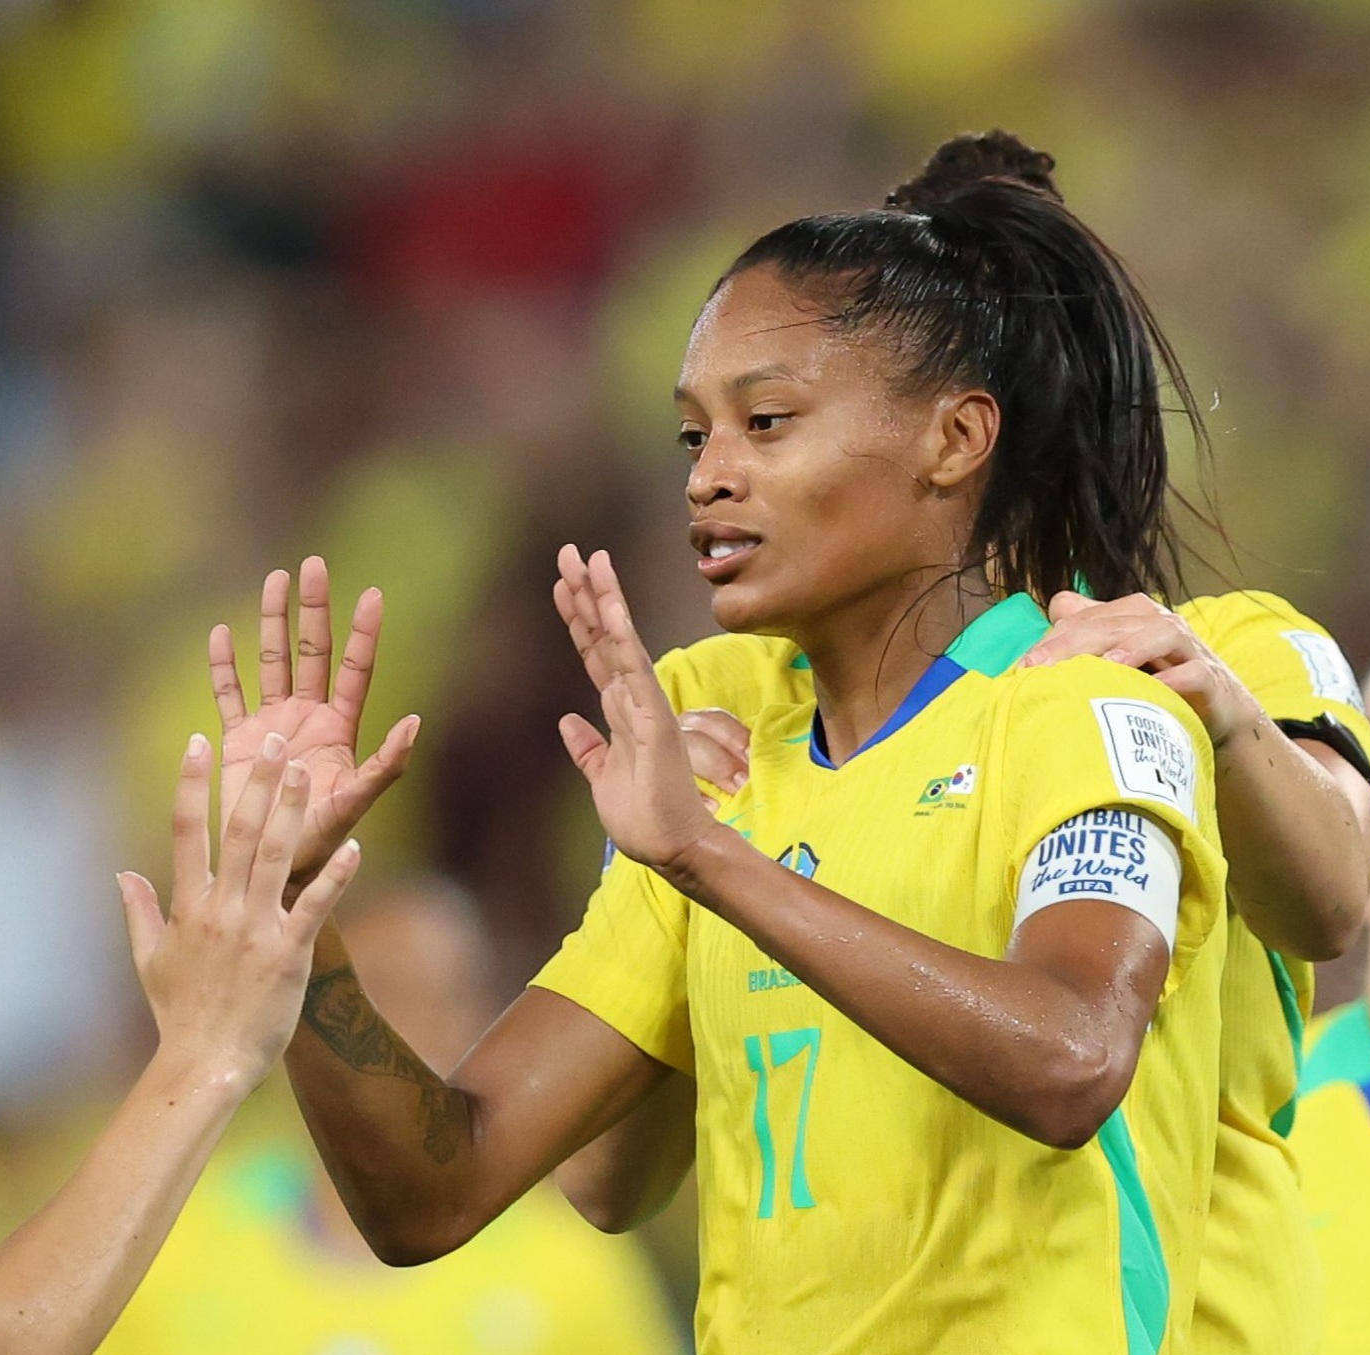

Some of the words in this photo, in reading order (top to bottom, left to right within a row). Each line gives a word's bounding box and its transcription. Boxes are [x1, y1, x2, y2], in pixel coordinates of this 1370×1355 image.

[1131, 728, 1185, 768] UNITES
[1133, 748, 1157, 763] the
[1037, 829, 1146, 867] UNITES
[1031, 866, 1067, 892] the
[1071, 858, 1149, 891] World
[1062, 880, 1110, 893] FIFA
[743, 1027, 821, 1220] 17
